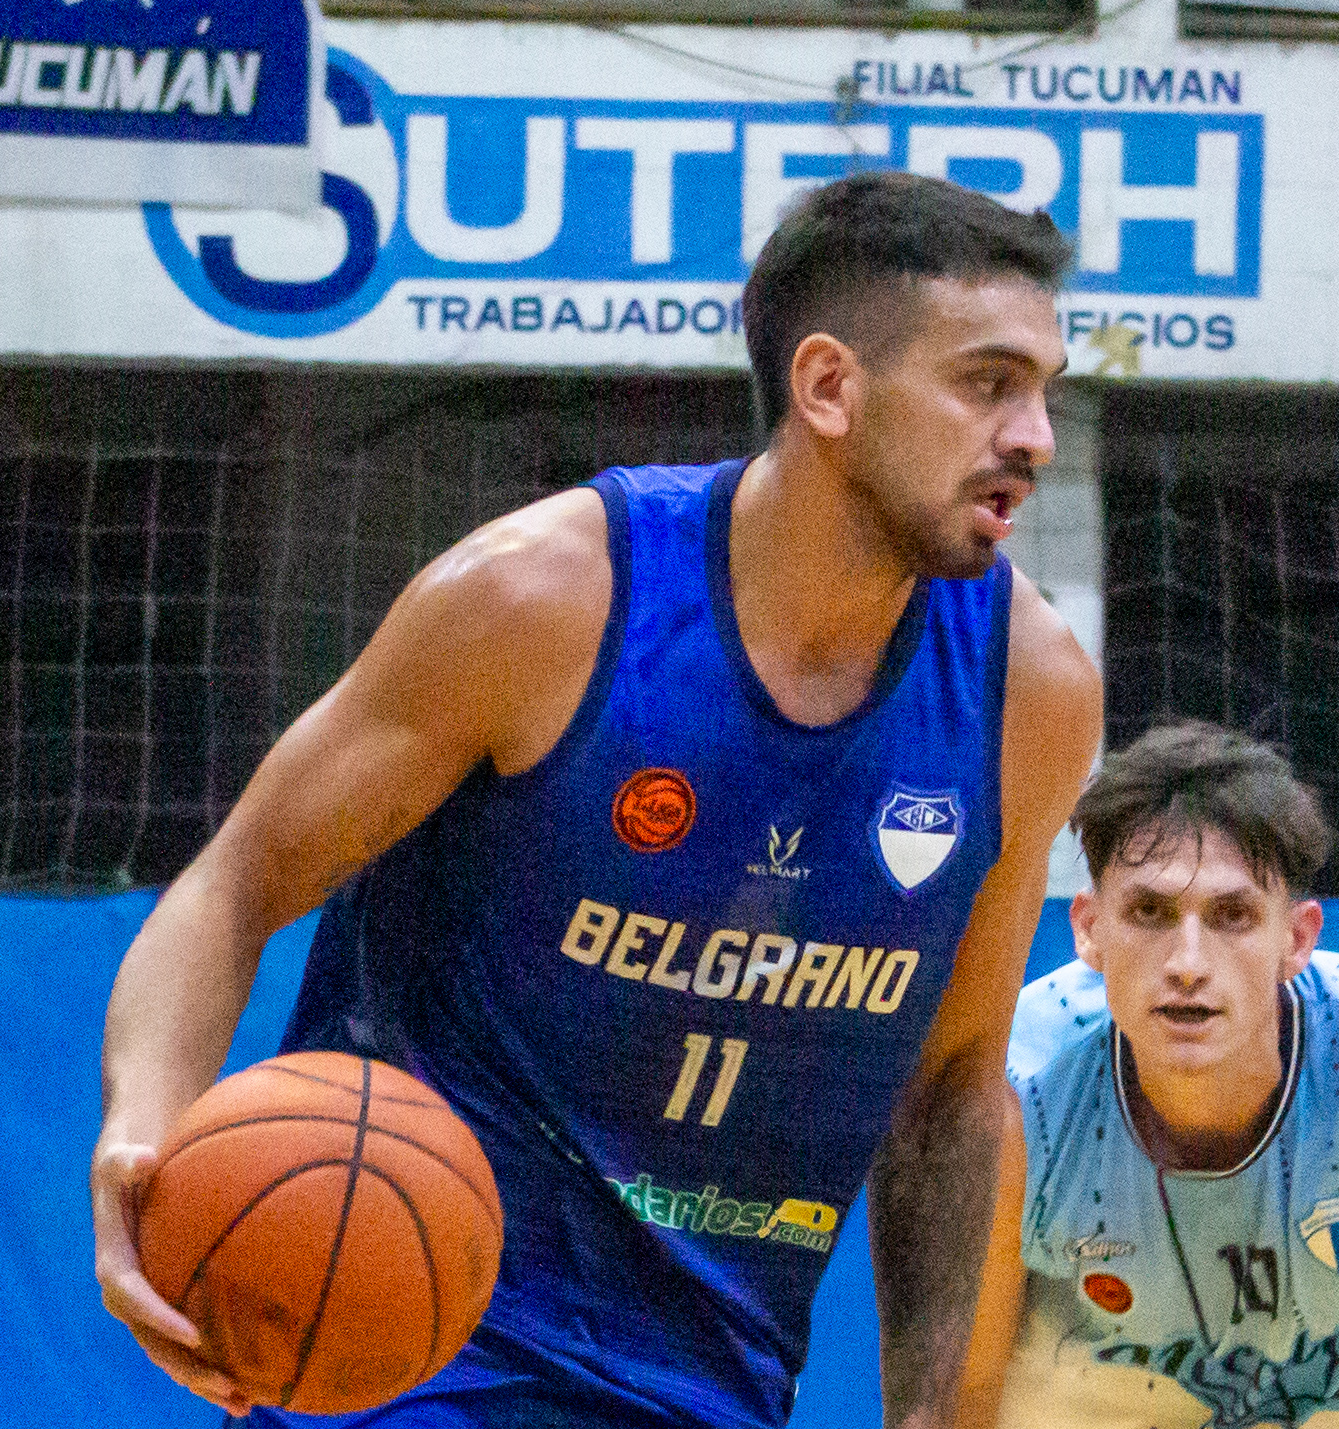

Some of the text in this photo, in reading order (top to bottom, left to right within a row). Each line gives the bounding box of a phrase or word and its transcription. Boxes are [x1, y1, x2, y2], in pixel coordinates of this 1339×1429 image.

[852, 60, 1242, 105] FILIAL TUCUMAN
[407, 294, 744, 336] TRABAJADO
[559, 898, 920, 1014] BELGRANO
[662, 1032, 750, 1127] 11
